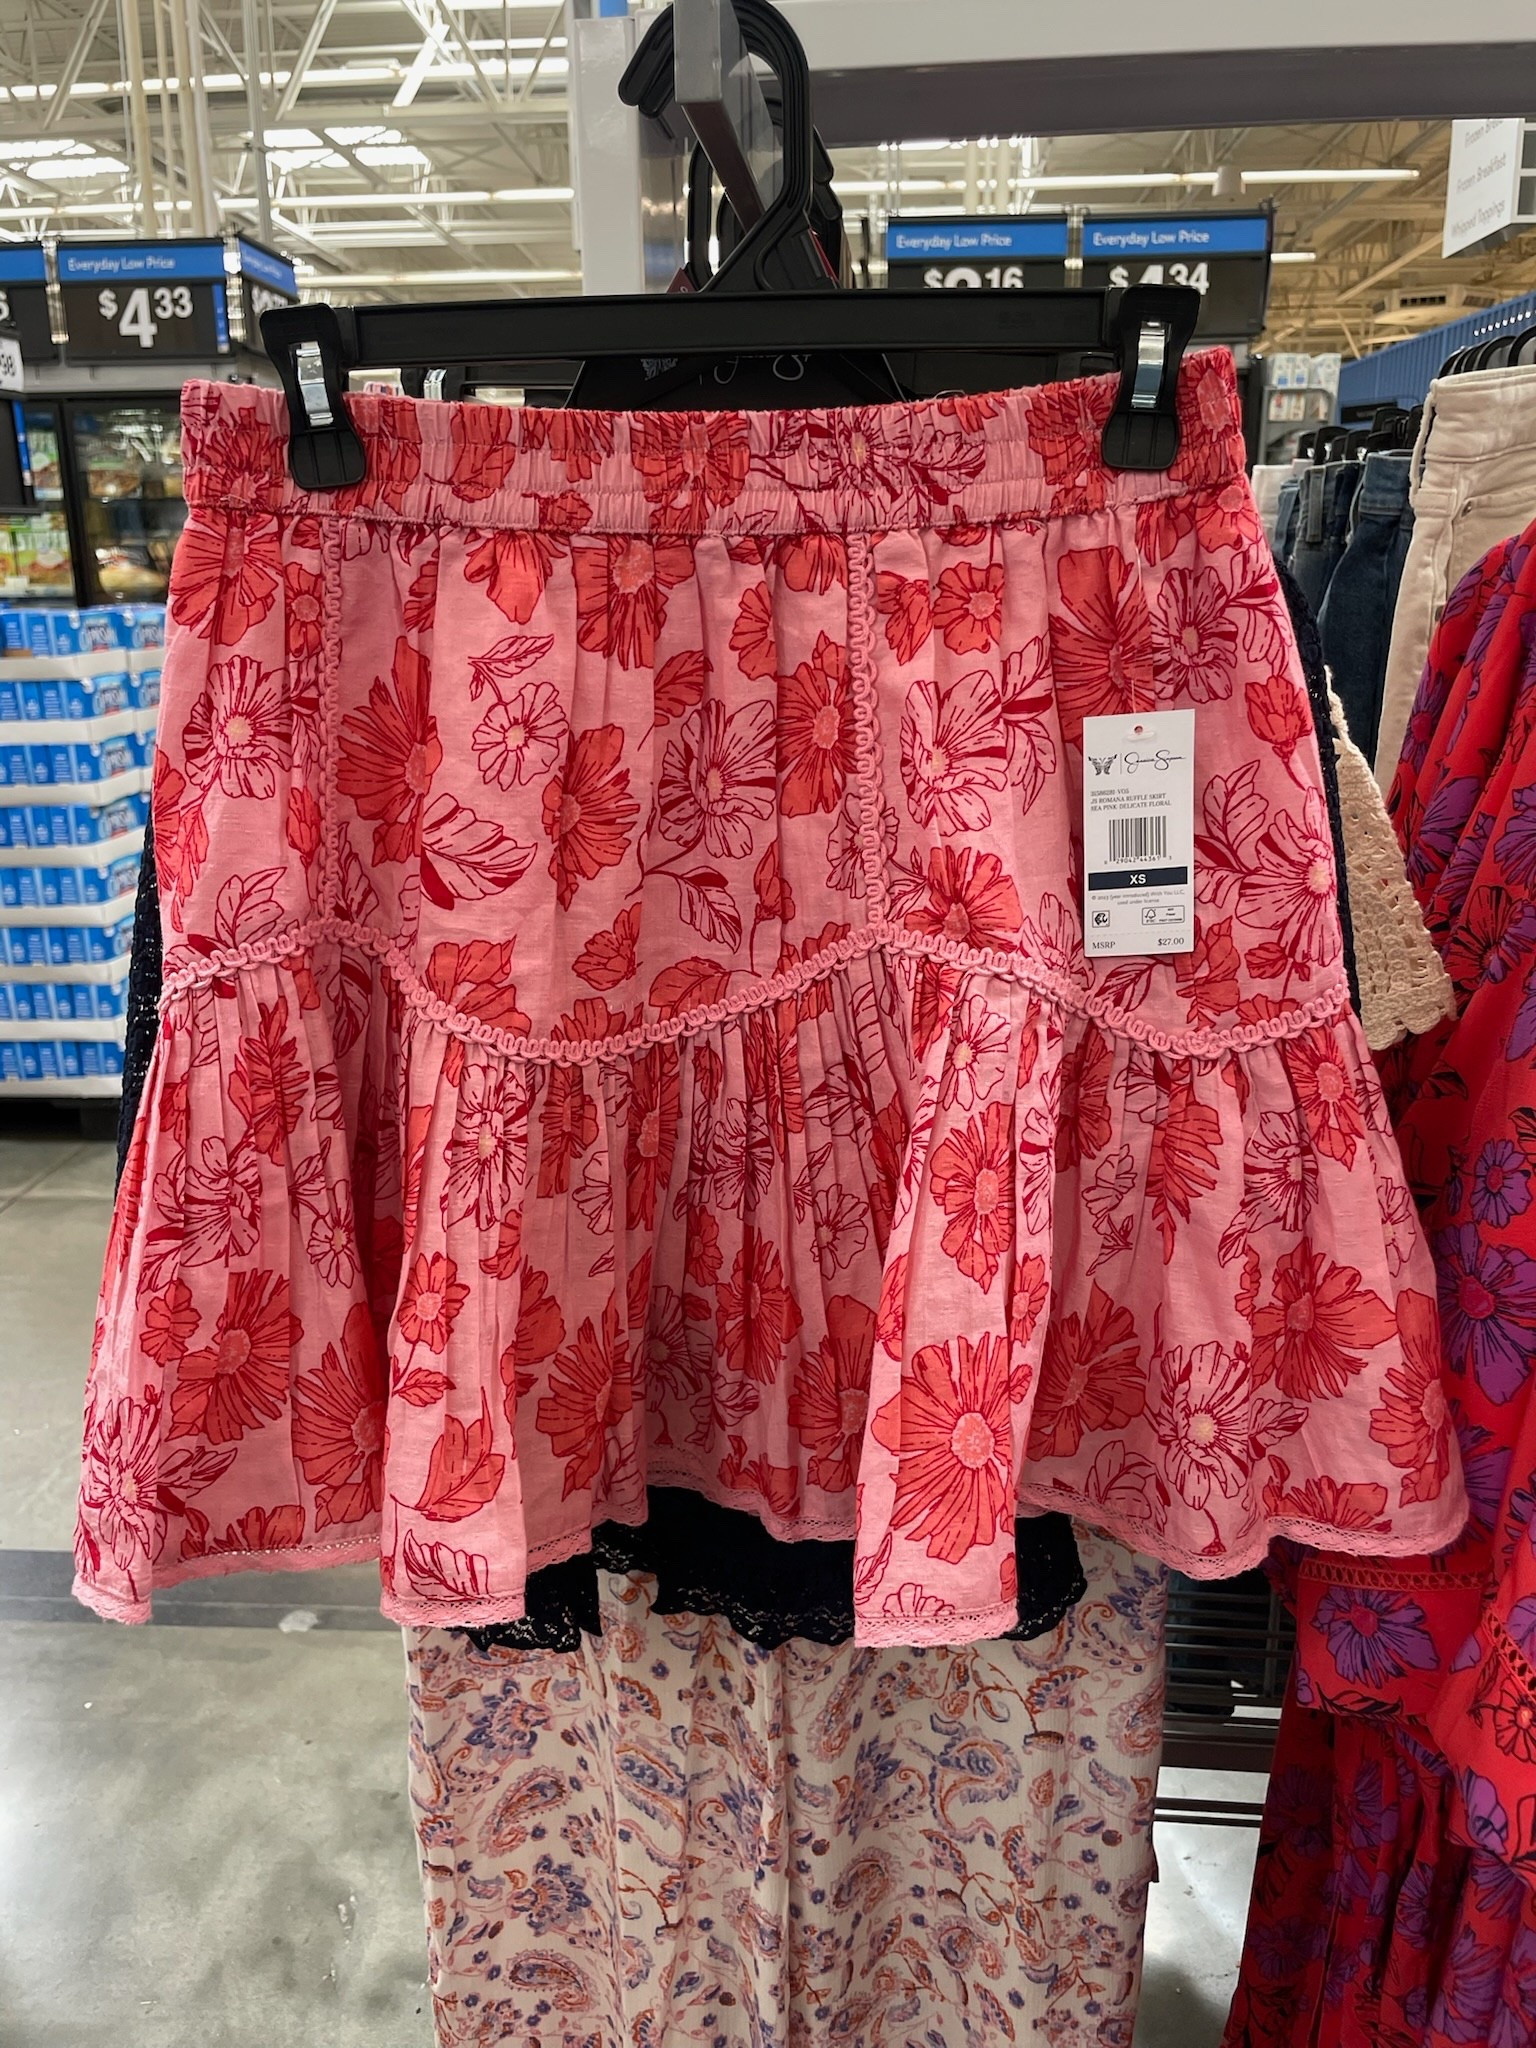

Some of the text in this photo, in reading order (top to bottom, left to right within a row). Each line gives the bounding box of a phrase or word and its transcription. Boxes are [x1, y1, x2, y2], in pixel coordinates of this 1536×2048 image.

[895, 233, 1012, 251] Everyday Low Price
[1092, 229, 1210, 248] Everyday Low Price
[67, 255, 176, 274] Everyday Low Price
[1099, 796, 1125, 804] ROMANA
[1126, 794, 1148, 802] RUFFLE
[1149, 792, 1167, 800] SKIRT
[1119, 802, 1148, 810] DELICATE
[1149, 800, 1172, 808] FLORAL
[1129, 874, 1147, 885] XS
[1092, 941, 1116, 950] MSRP
[1157, 938, 1185, 946] $27.00
